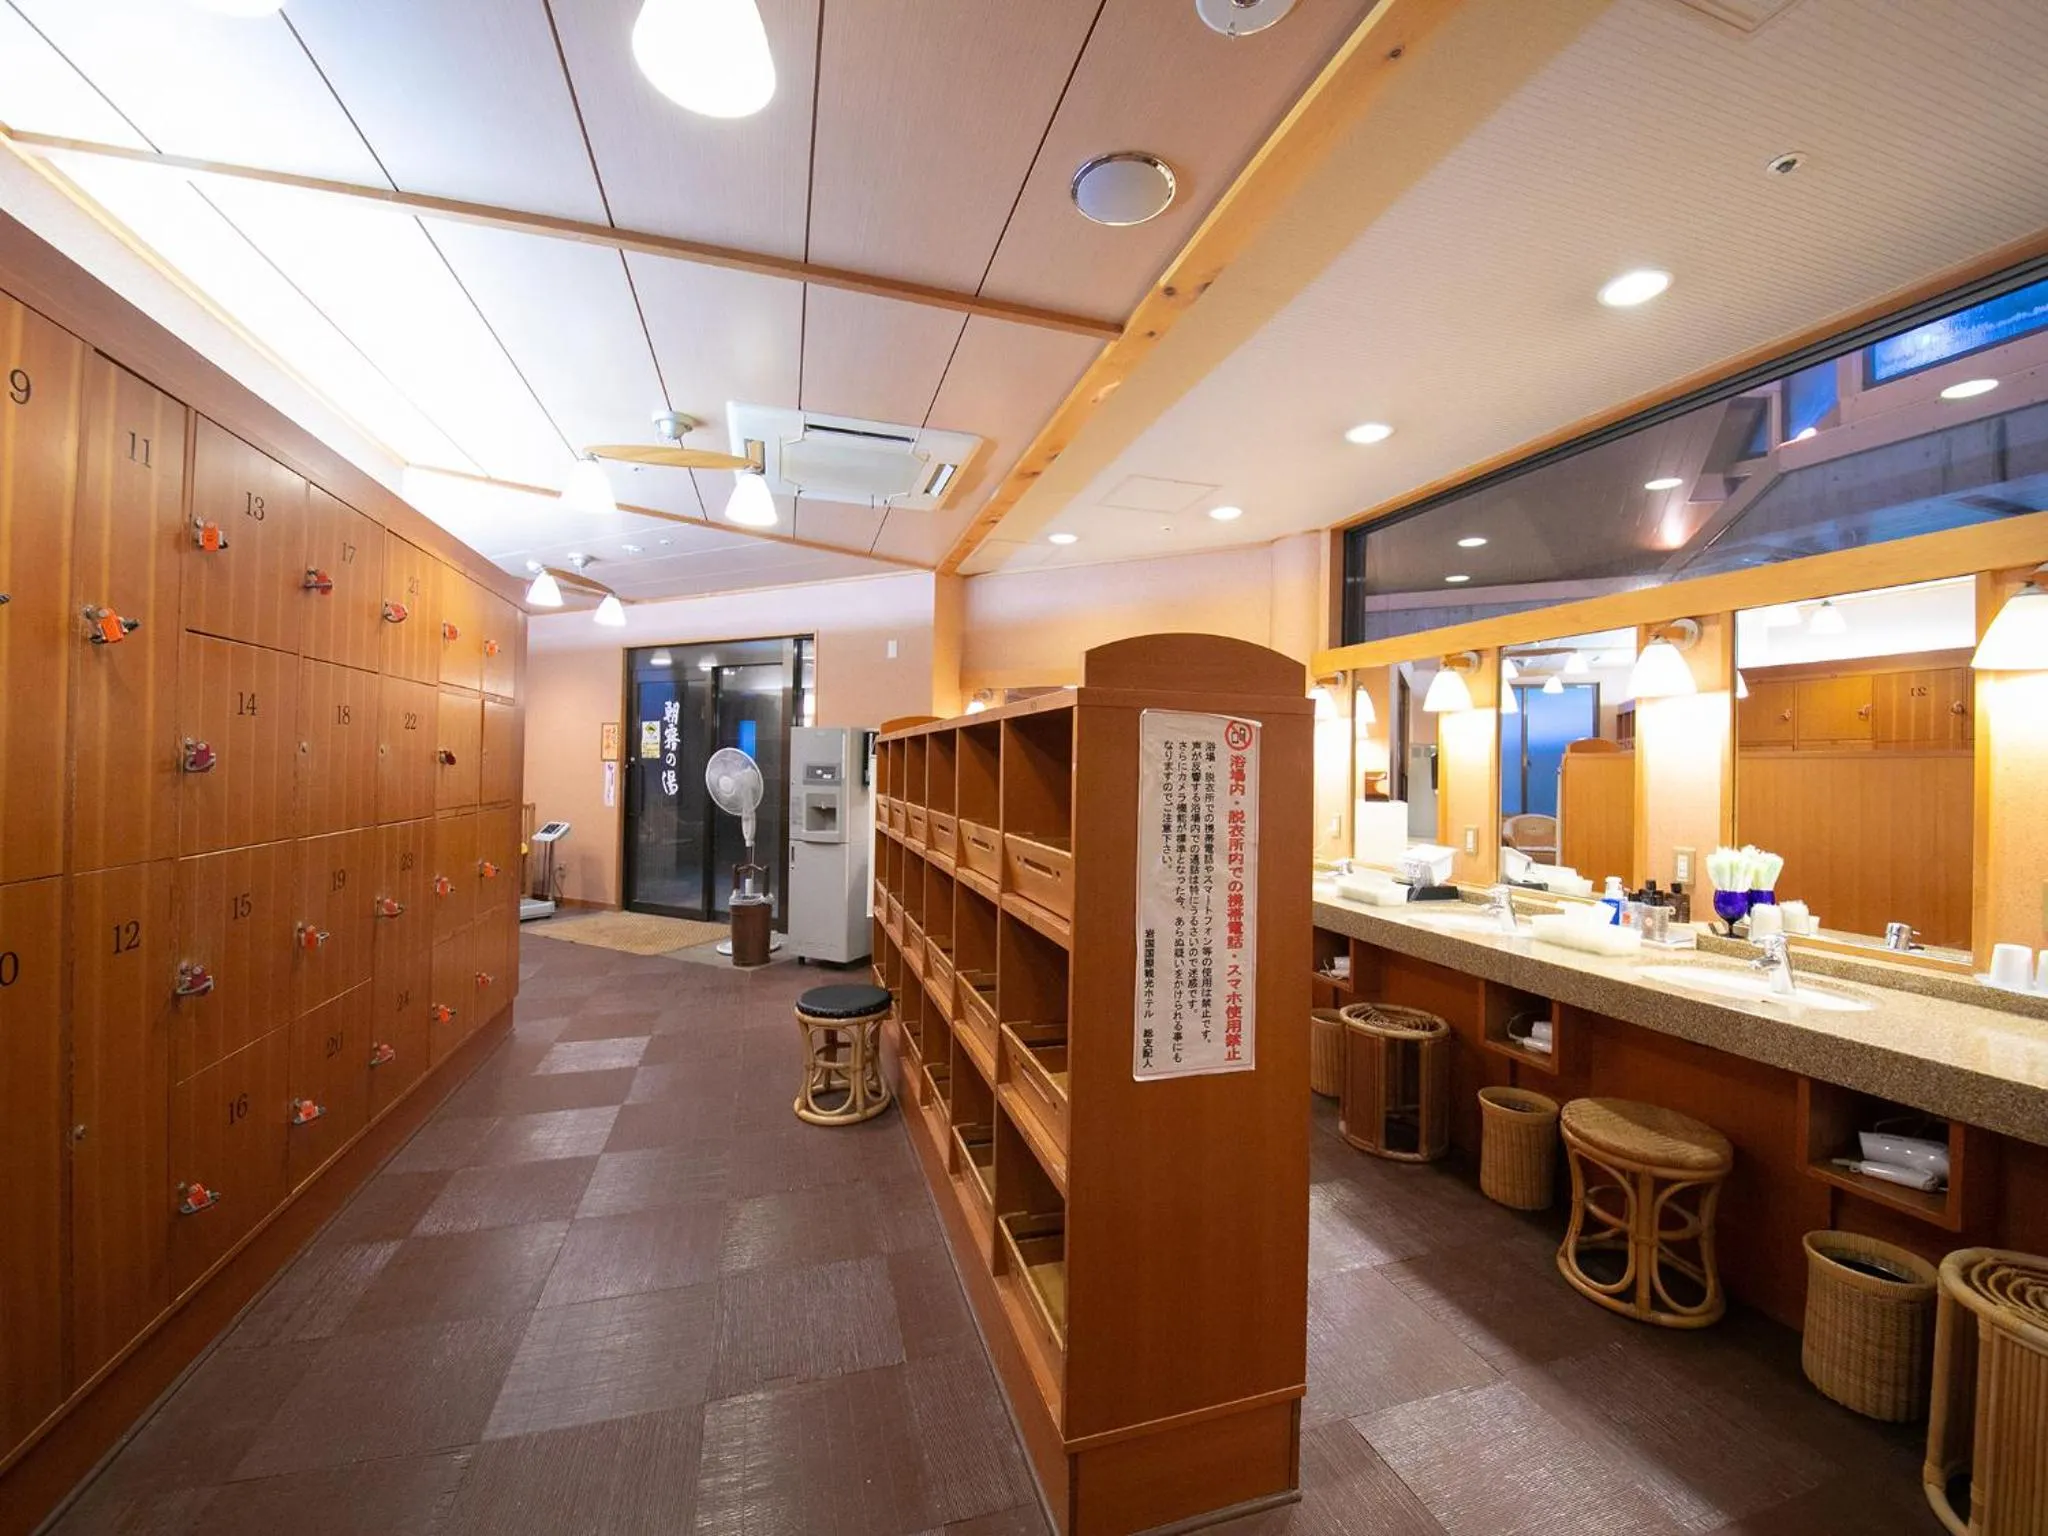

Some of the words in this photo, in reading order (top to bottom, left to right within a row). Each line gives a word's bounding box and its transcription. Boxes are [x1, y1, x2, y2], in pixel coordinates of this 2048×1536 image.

[9, 368, 32, 405] 9
[127, 431, 152, 469] 11
[245, 491, 265, 521] 13
[342, 542, 356, 564] 17
[408, 575, 420, 596] 21
[236, 692, 257, 716] 14
[337, 705, 350, 725] 18
[404, 712, 417, 730] 22
[400, 852, 414, 871] 23
[331, 869, 346, 891] 19
[232, 893, 252, 920] 15
[1224, 754, 1246, 1061] 浴場内・脱衣所内での携帯電話・スマホ使用禁止
[112, 920, 141, 955] 12
[228, 1093, 248, 1125] 16
